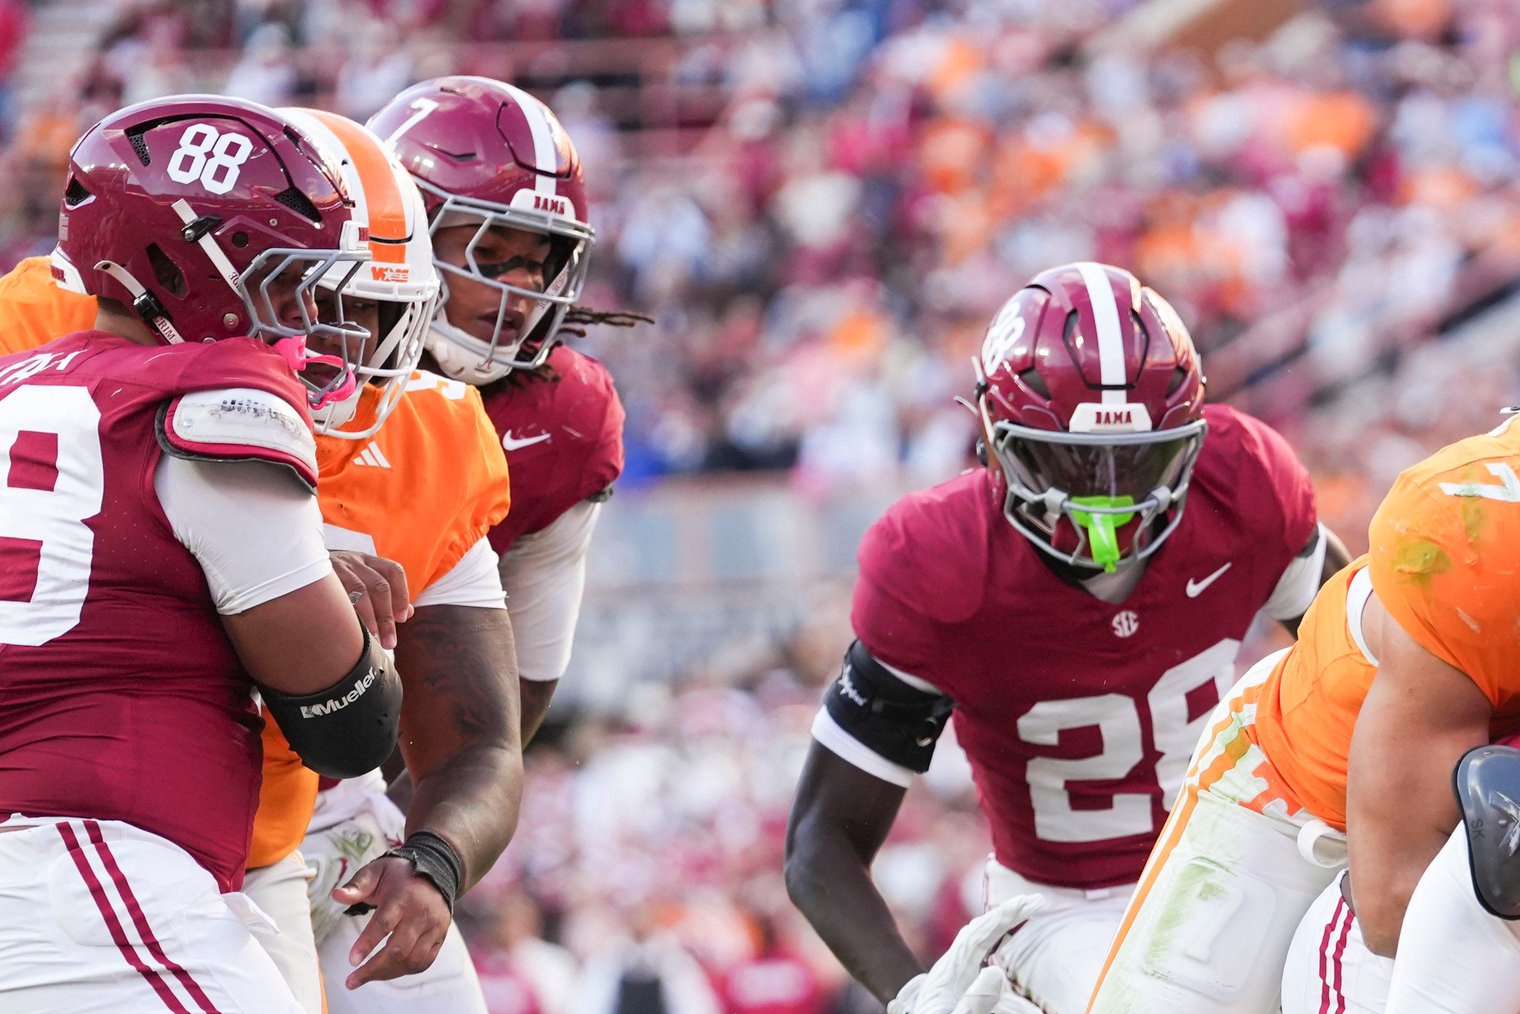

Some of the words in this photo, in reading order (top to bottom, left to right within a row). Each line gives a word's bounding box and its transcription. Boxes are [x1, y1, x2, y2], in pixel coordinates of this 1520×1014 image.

[385, 97, 438, 152] 7
[167, 123, 253, 195] 88
[534, 196, 565, 215] BAMA
[1095, 411, 1132, 425] BAMA
[1112, 610, 1139, 638] SEC
[317, 666, 377, 717] Mueller
[1017, 637, 1241, 843] 28
